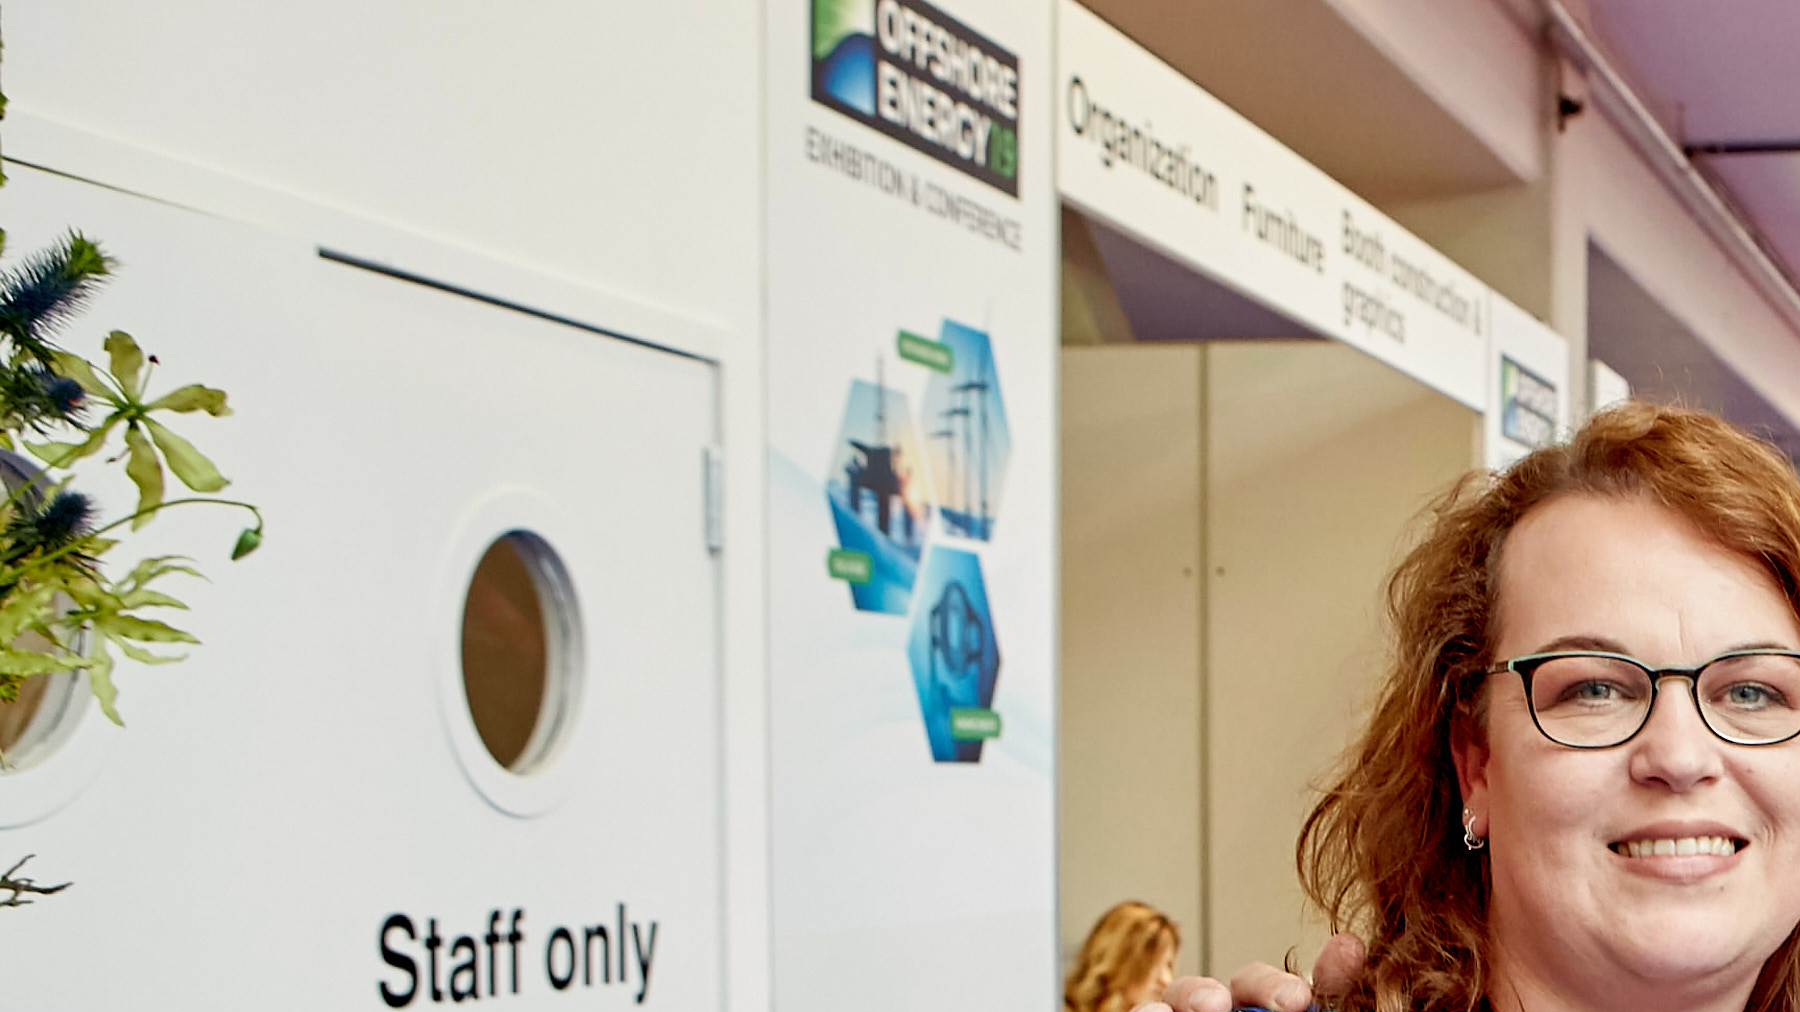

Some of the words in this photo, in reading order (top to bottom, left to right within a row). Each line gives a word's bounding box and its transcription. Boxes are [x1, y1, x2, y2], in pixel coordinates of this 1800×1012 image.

[877, 0, 1017, 120] OFFSHORE
[806, 124, 906, 197] EXHIBITION
[925, 180, 1022, 251] CONFERENCE
[1067, 76, 1218, 213] Organization
[1242, 180, 1325, 274] Furniture
[1342, 209, 1385, 273] Booth
[1390, 252, 1470, 327] construction
[1342, 280, 1405, 343] graphics
[378, 907, 524, 1008] Staff
[546, 901, 658, 1004] only
